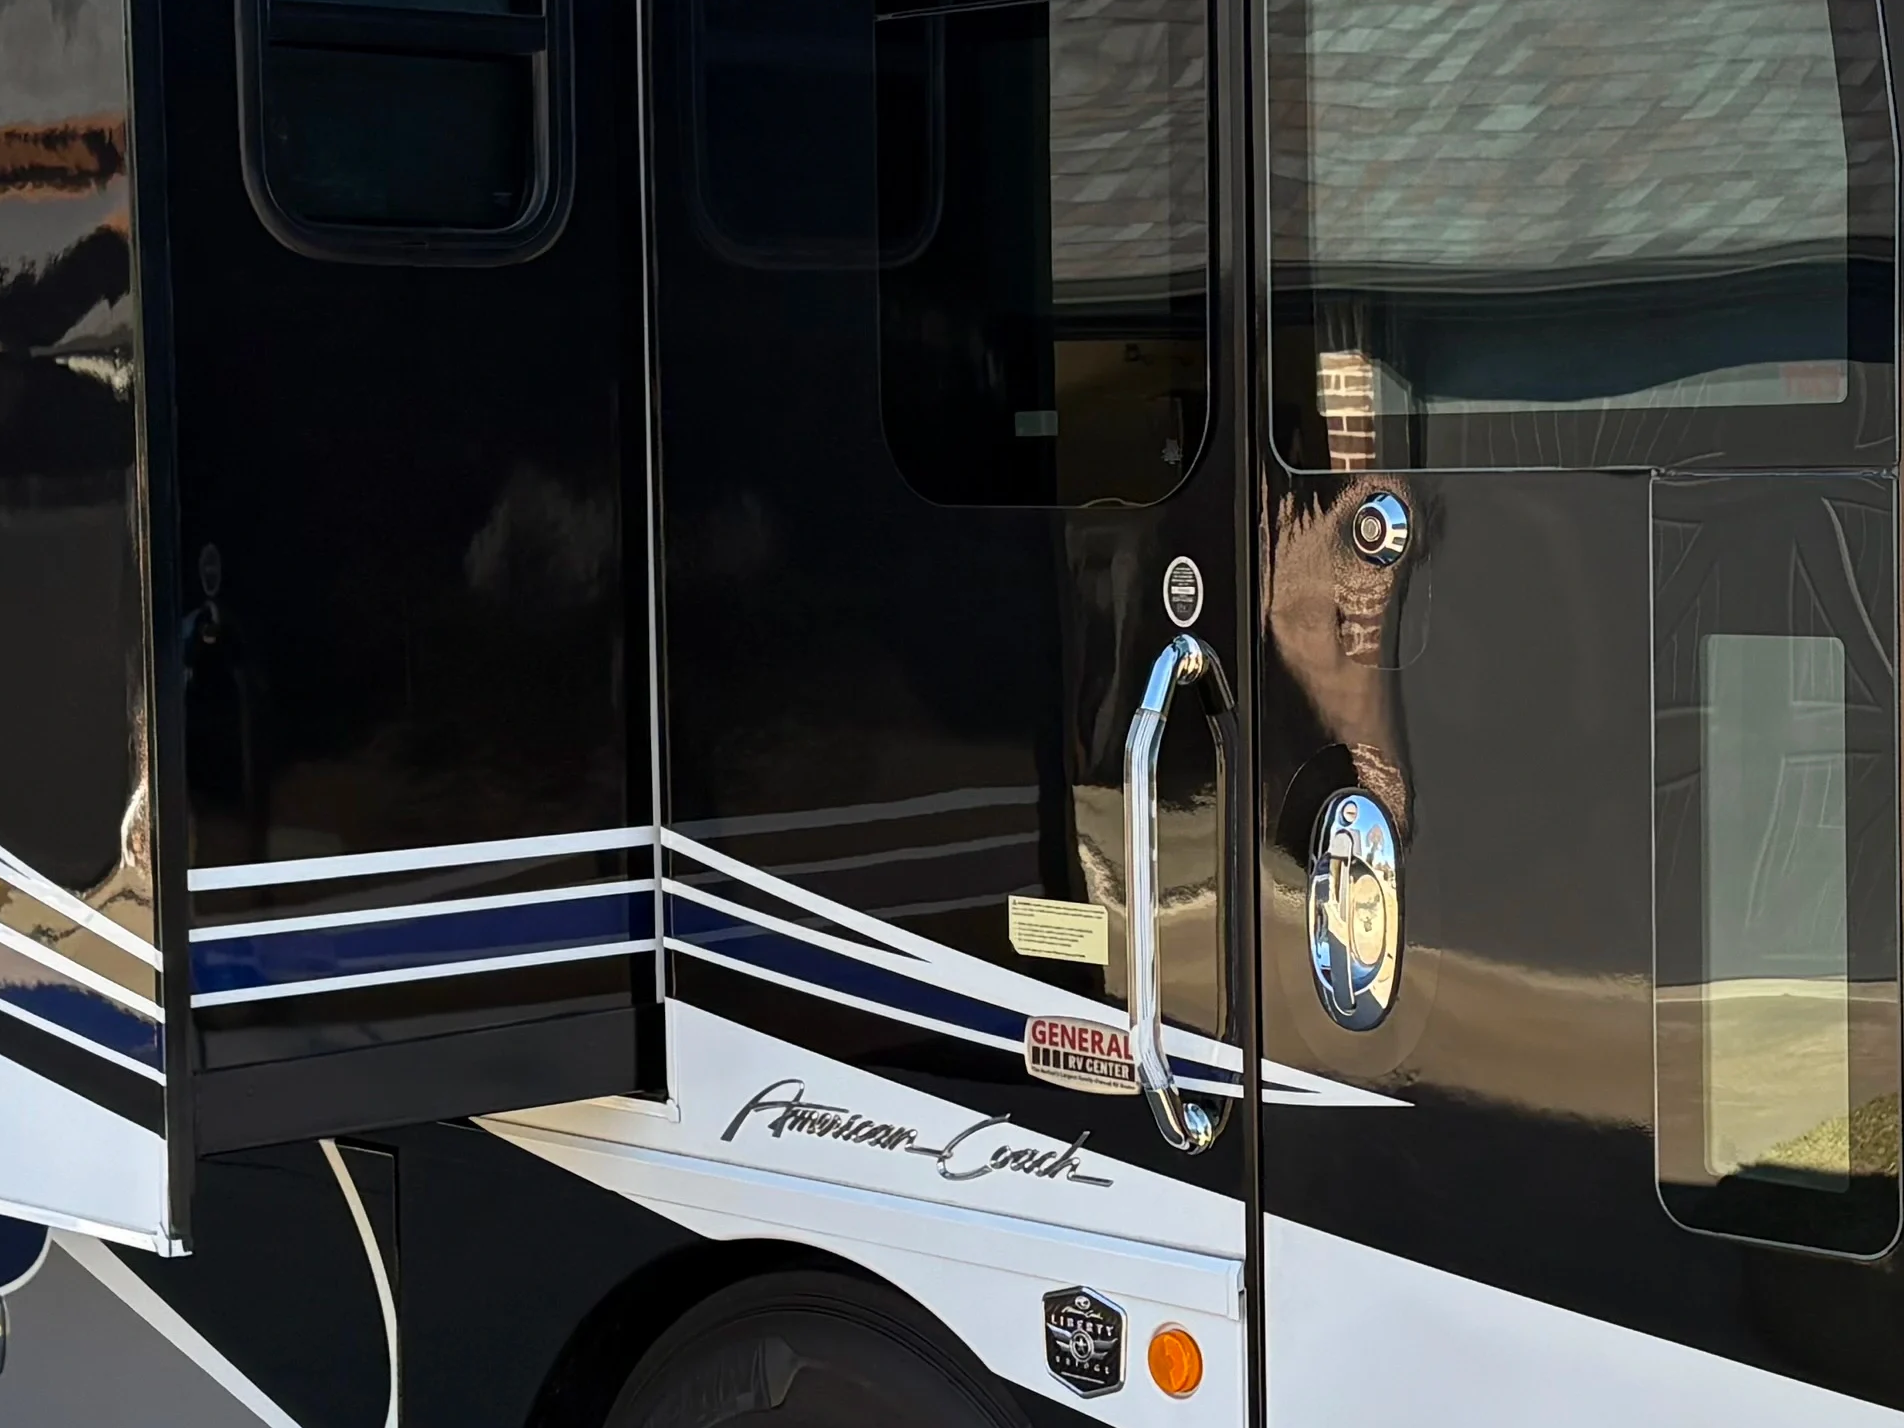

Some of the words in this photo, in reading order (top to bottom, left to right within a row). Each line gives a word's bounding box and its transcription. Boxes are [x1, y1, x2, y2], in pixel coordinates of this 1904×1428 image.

[1031, 1019, 1134, 1061] GENERAL
[1067, 1055, 1084, 1071] RV
[1085, 1058, 1129, 1080] CENTER
[721, 1079, 946, 1156] American
[936, 1113, 1114, 1188] Coach
[1050, 1314, 1114, 1336] LIBERTY
